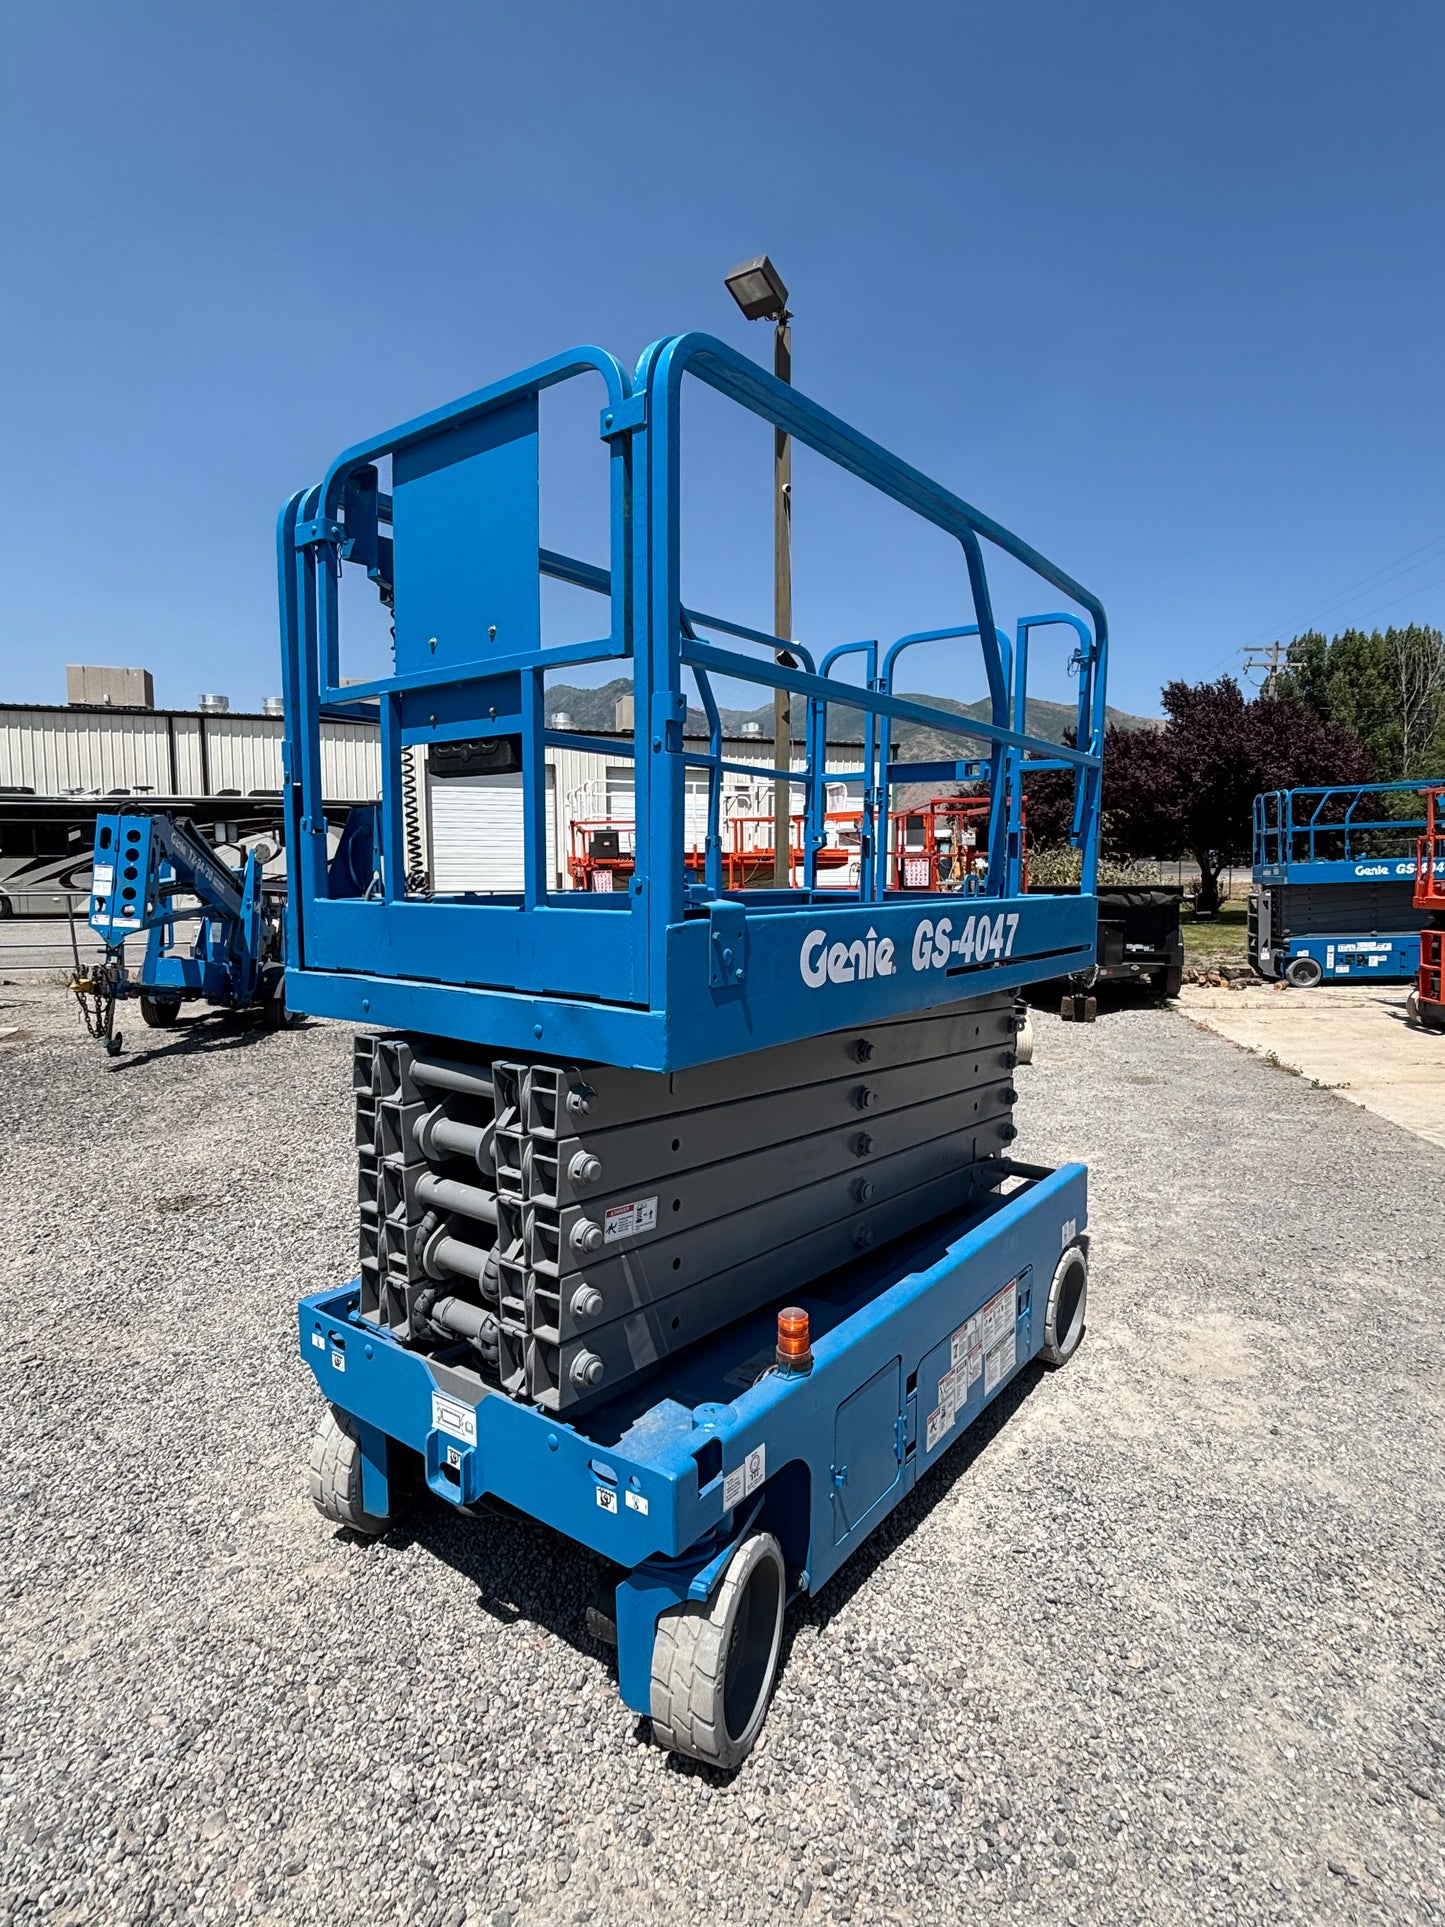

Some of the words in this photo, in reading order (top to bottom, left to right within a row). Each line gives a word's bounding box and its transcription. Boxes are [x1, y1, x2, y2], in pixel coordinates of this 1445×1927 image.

[1354, 865, 1390, 876] Genie
[800, 926, 895, 989] Genie
[912, 913, 1019, 971] GS-4047
